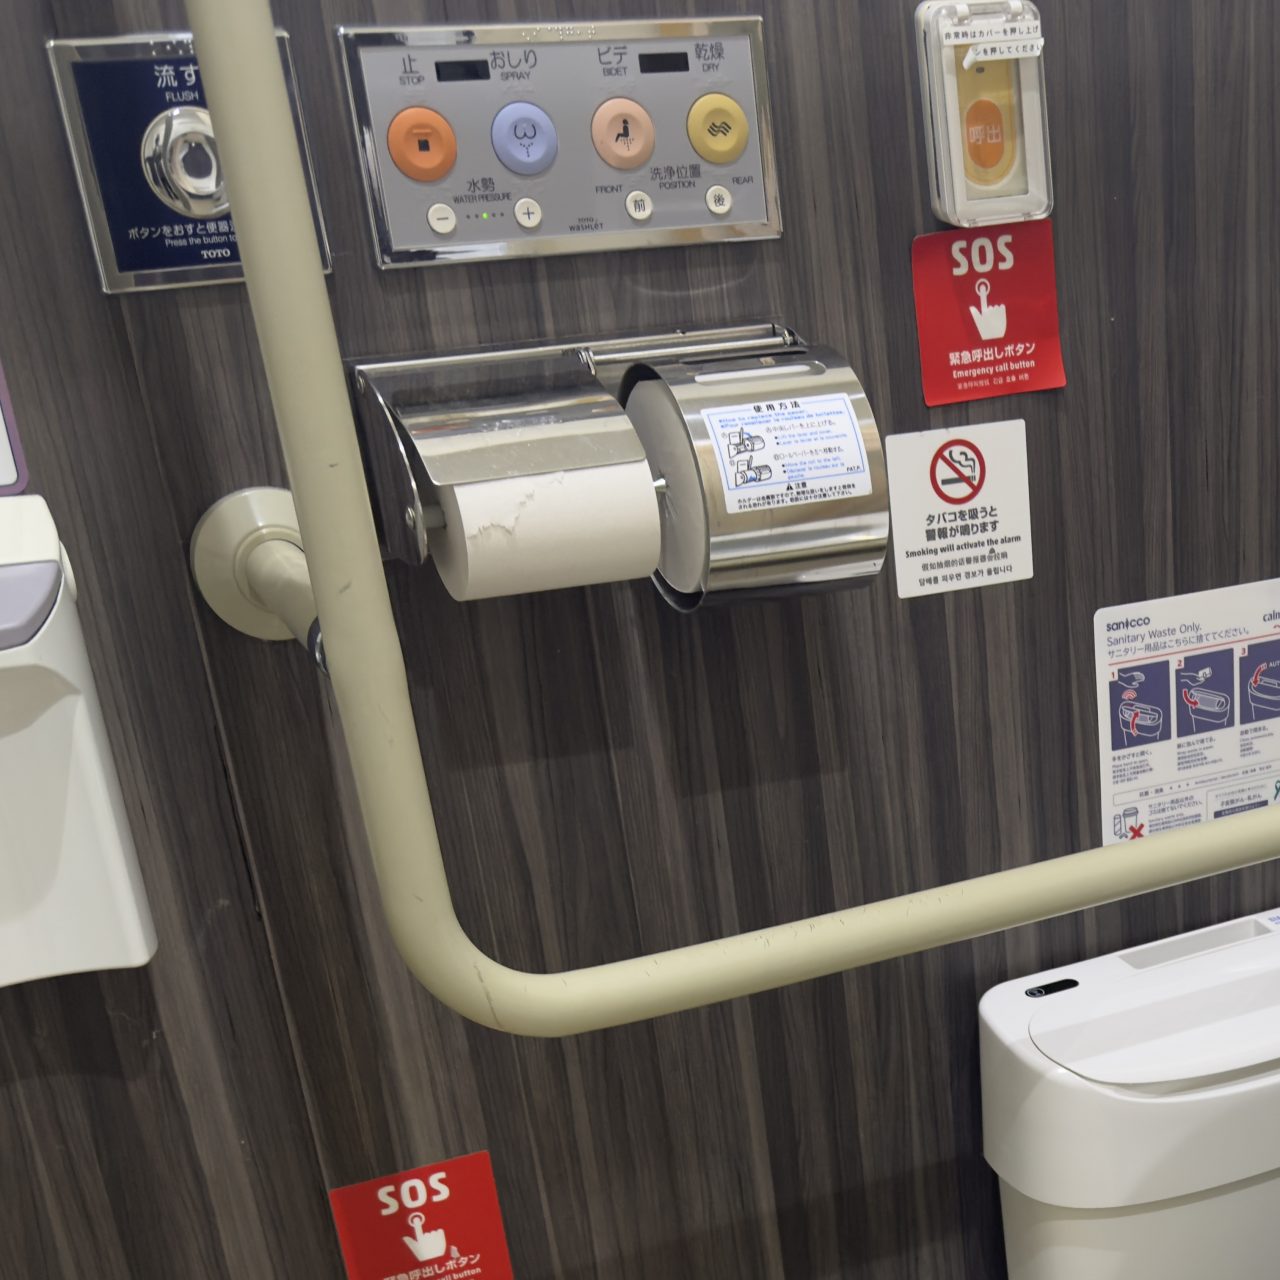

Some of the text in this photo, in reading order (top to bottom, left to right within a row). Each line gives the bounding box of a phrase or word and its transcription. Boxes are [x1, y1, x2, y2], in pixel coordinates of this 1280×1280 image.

[694, 42, 724, 60] 乾燥
[402, 54, 419, 74] 止
[490, 50, 537, 69] おしり
[603, 67, 627, 76] BIDET
[702, 63, 720, 72] DRY
[153, 63, 199, 88] 流す
[399, 75, 425, 86] STOP
[501, 71, 531, 81] SPRAY
[165, 91, 199, 102] FLUSH
[650, 164, 701, 180] 洗浄位置
[595, 185, 623, 193] FRONT
[659, 180, 696, 189] POSITION
[453, 192, 511, 204] WATER PRESSURE
[714, 194, 725, 207] 後
[633, 199, 645, 212] 前
[165, 239, 188, 248] Press
[189, 237, 202, 245] the
[203, 234, 228, 244] button
[201, 248, 231, 260] TOTO
[951, 234, 1014, 276] SOS
[949, 343, 1036, 366] 緊急呼出しボタン
[952, 360, 1035, 379] Emergency call button
[753, 401, 800, 413] 使用方法
[926, 506, 998, 526] タバコを吸うと
[925, 520, 999, 542] 警報が鳴ります
[905, 535, 1021, 559] Smoking will activate the alarm
[1107, 621, 1202, 647] Sanitary Waste Only.
[1241, 647, 1247, 655] 3
[1177, 659, 1183, 667] 2
[1111, 671, 1115, 679] 1
[377, 1171, 450, 1216] SOS
[453, 1267, 481, 1280] button
